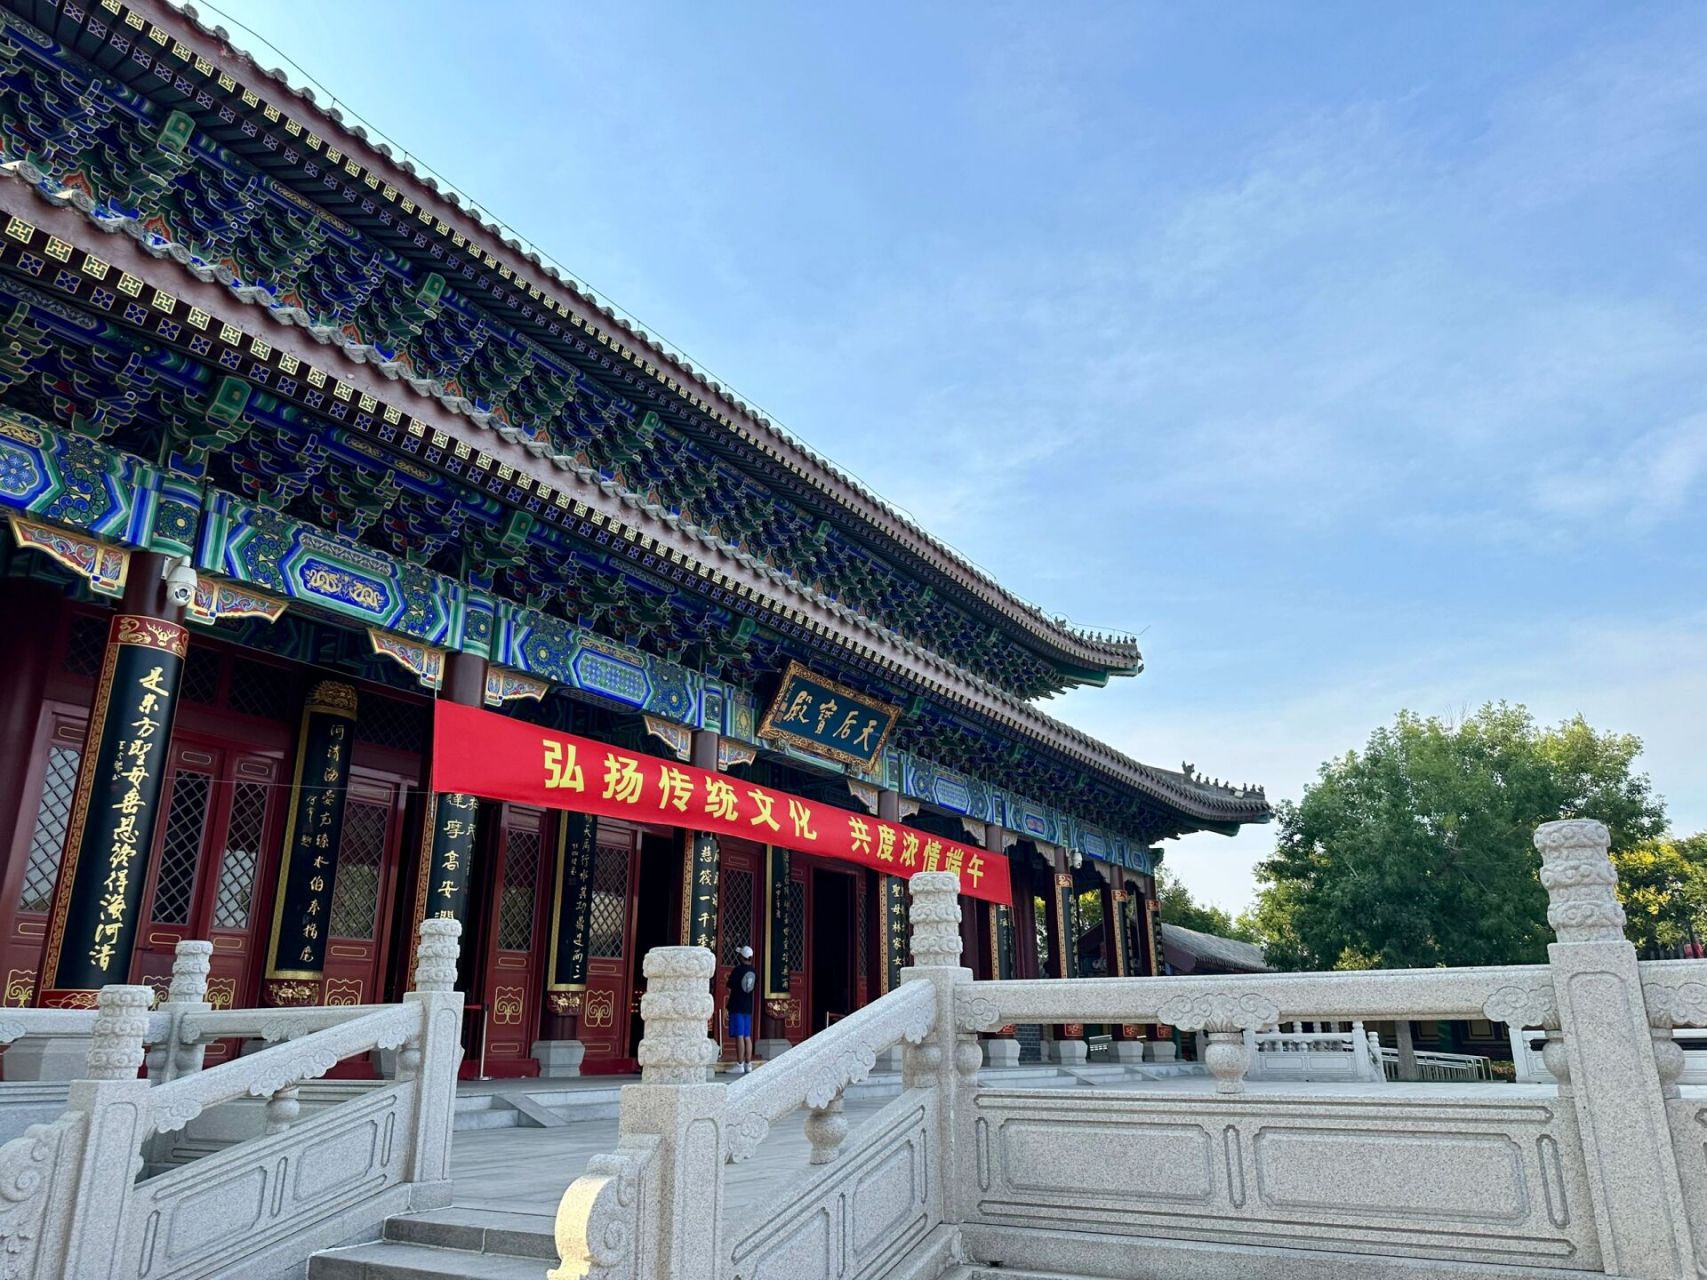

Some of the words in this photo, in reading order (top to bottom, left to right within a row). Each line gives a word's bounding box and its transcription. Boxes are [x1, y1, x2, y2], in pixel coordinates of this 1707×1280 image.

[541, 740, 817, 839] 弘扬传统文化
[848, 817, 984, 888] 共度浓情端午
